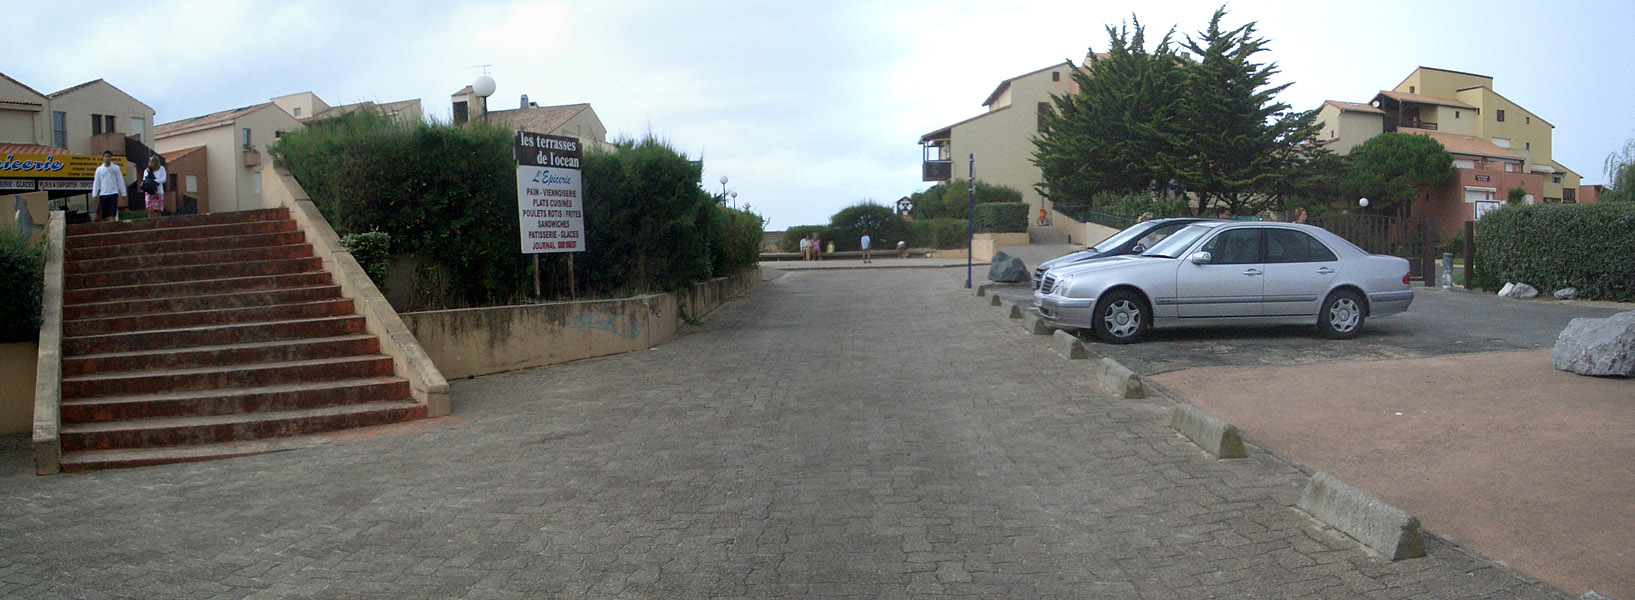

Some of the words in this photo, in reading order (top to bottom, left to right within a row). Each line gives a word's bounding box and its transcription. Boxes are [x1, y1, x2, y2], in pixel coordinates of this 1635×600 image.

[520, 132, 534, 147] les
[536, 135, 577, 151] terrasses
[537, 151, 548, 165] de
[526, 188, 539, 196] PAIN
[543, 189, 576, 197] VIENNOISERIE
[533, 199, 549, 207] PLATS
[523, 209, 547, 217] POULETS
[566, 210, 581, 218] FRITES
[538, 220, 569, 228] SANDWICHES
[529, 231, 557, 239] PATISSERIE
[561, 230, 579, 238] GLACES
[532, 241, 555, 250] JOURNAL
